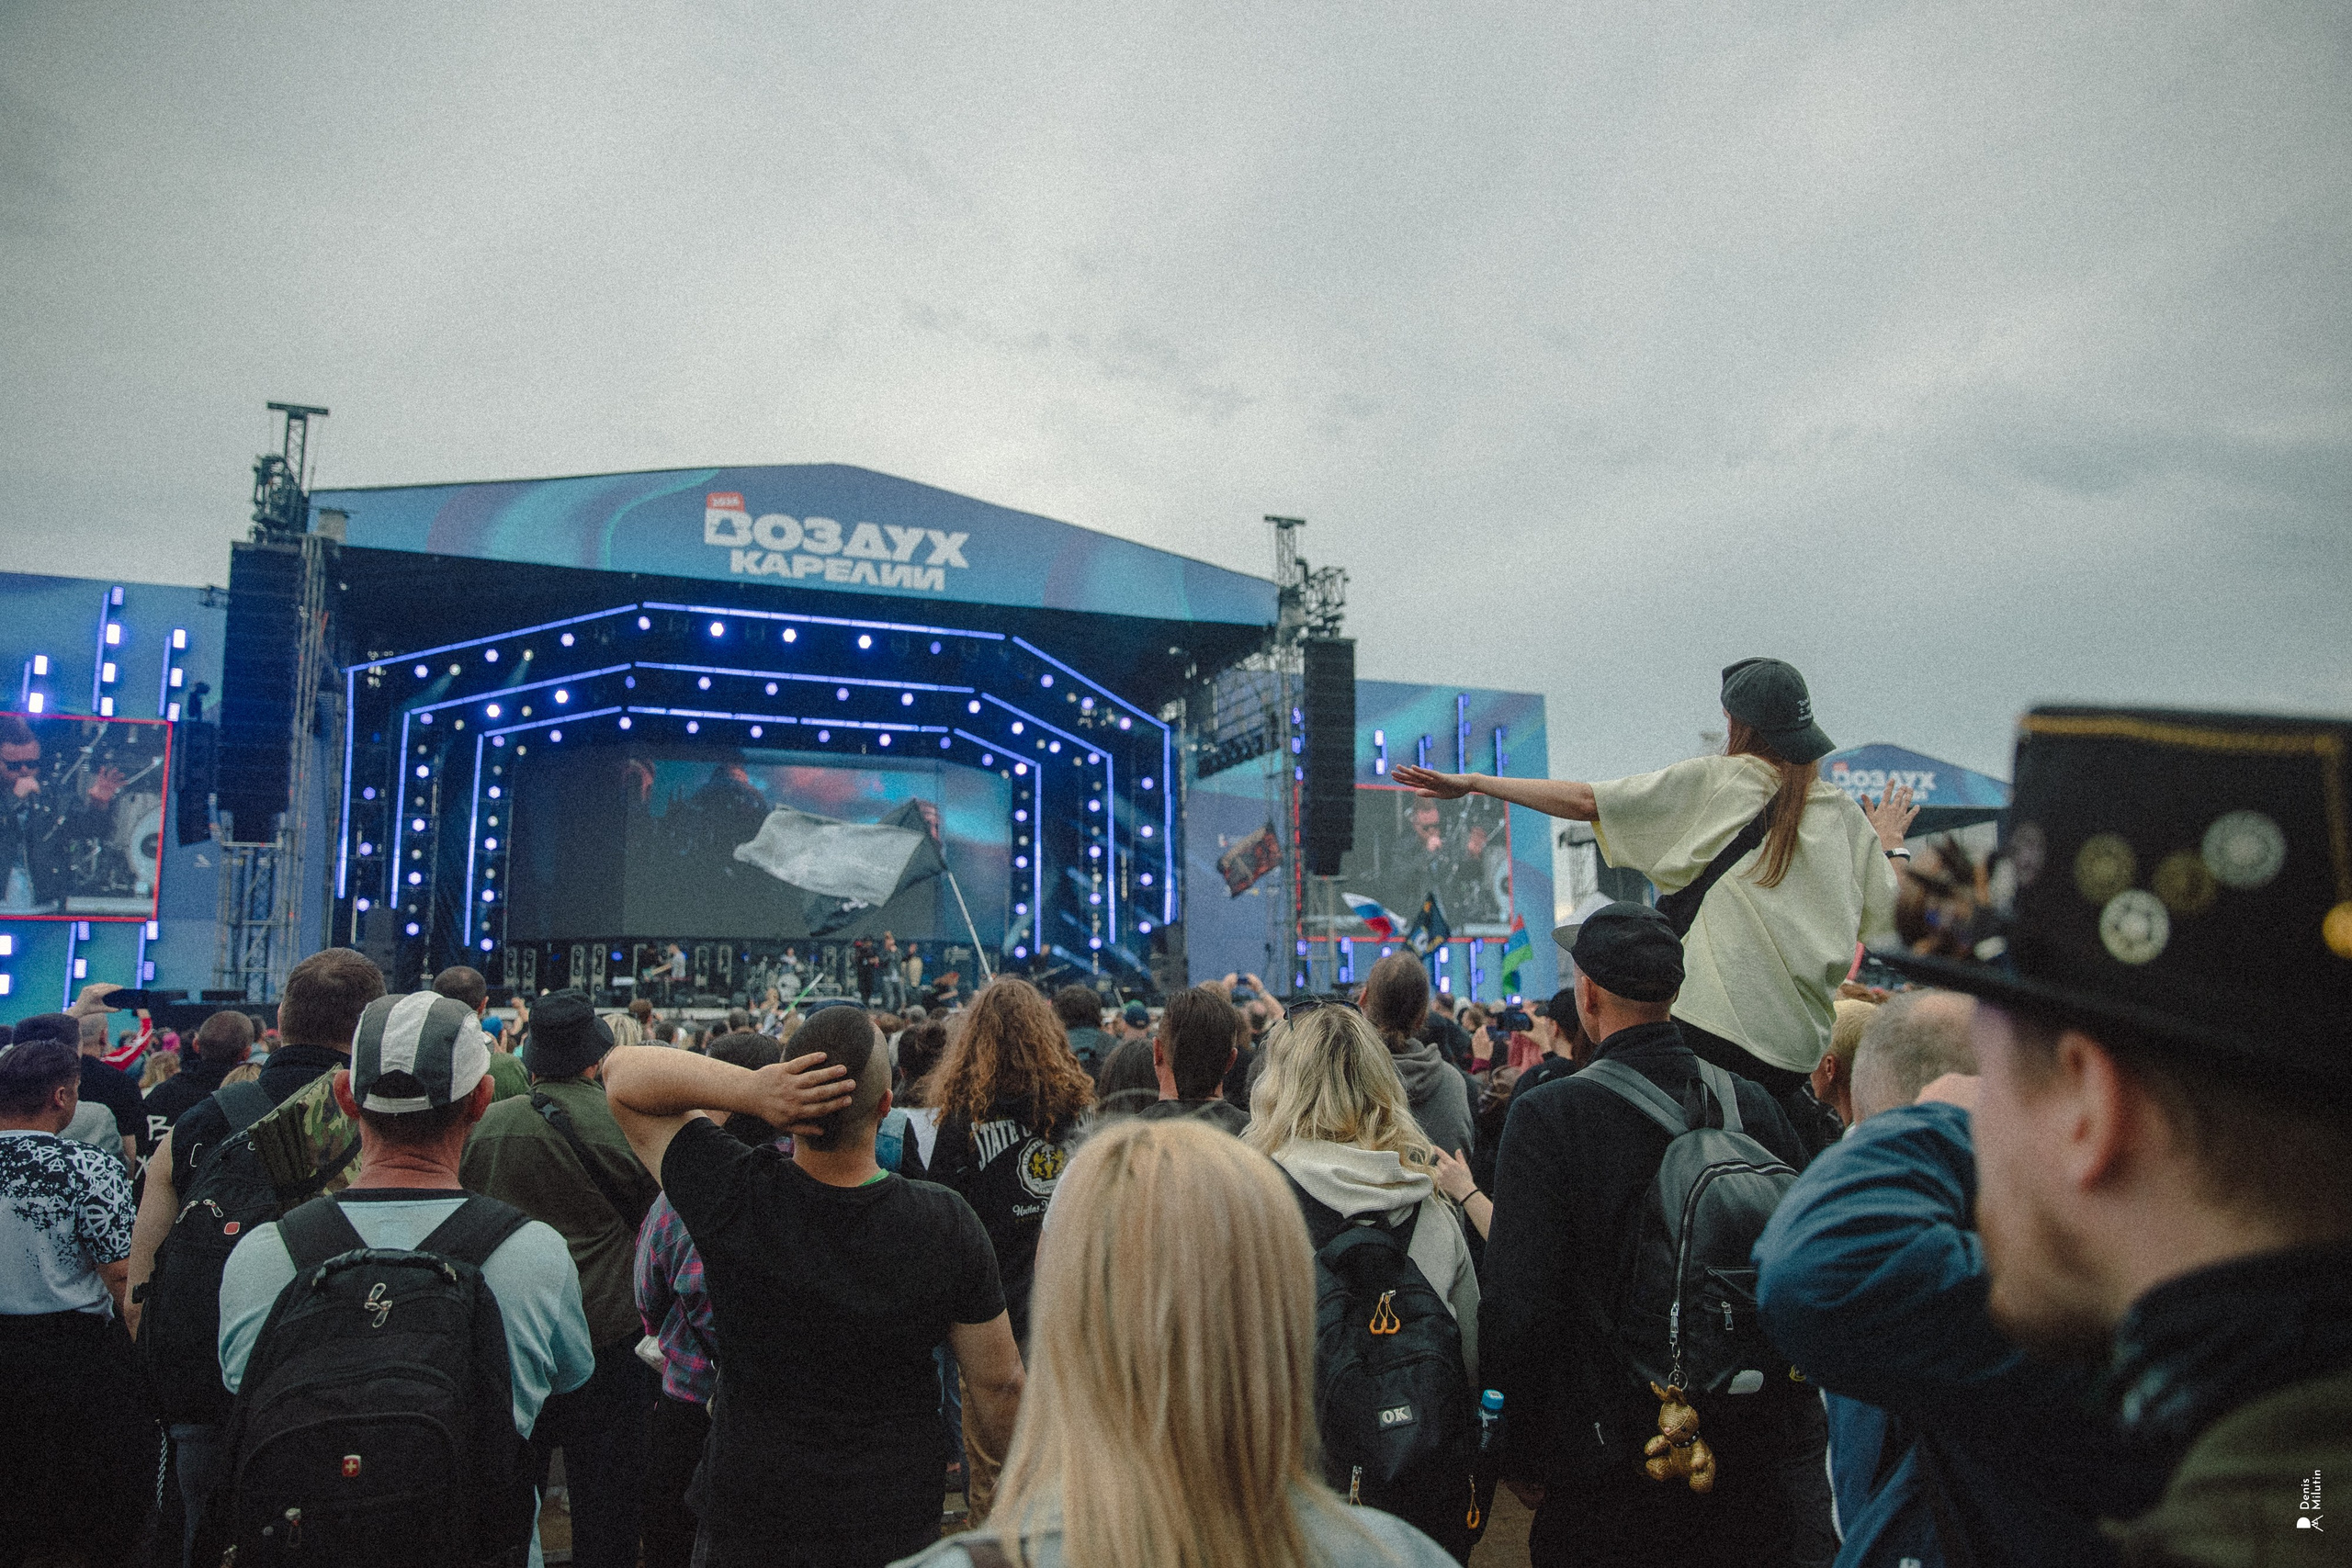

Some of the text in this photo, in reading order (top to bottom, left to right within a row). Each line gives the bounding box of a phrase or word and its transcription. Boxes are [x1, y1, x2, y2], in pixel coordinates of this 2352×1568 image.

[704, 507, 970, 568] ВОЗДУХ
[729, 548, 945, 592] КАРЕЛИИ
[970, 1119, 1020, 1172] STATE
[1381, 1407, 1408, 1425] OK
